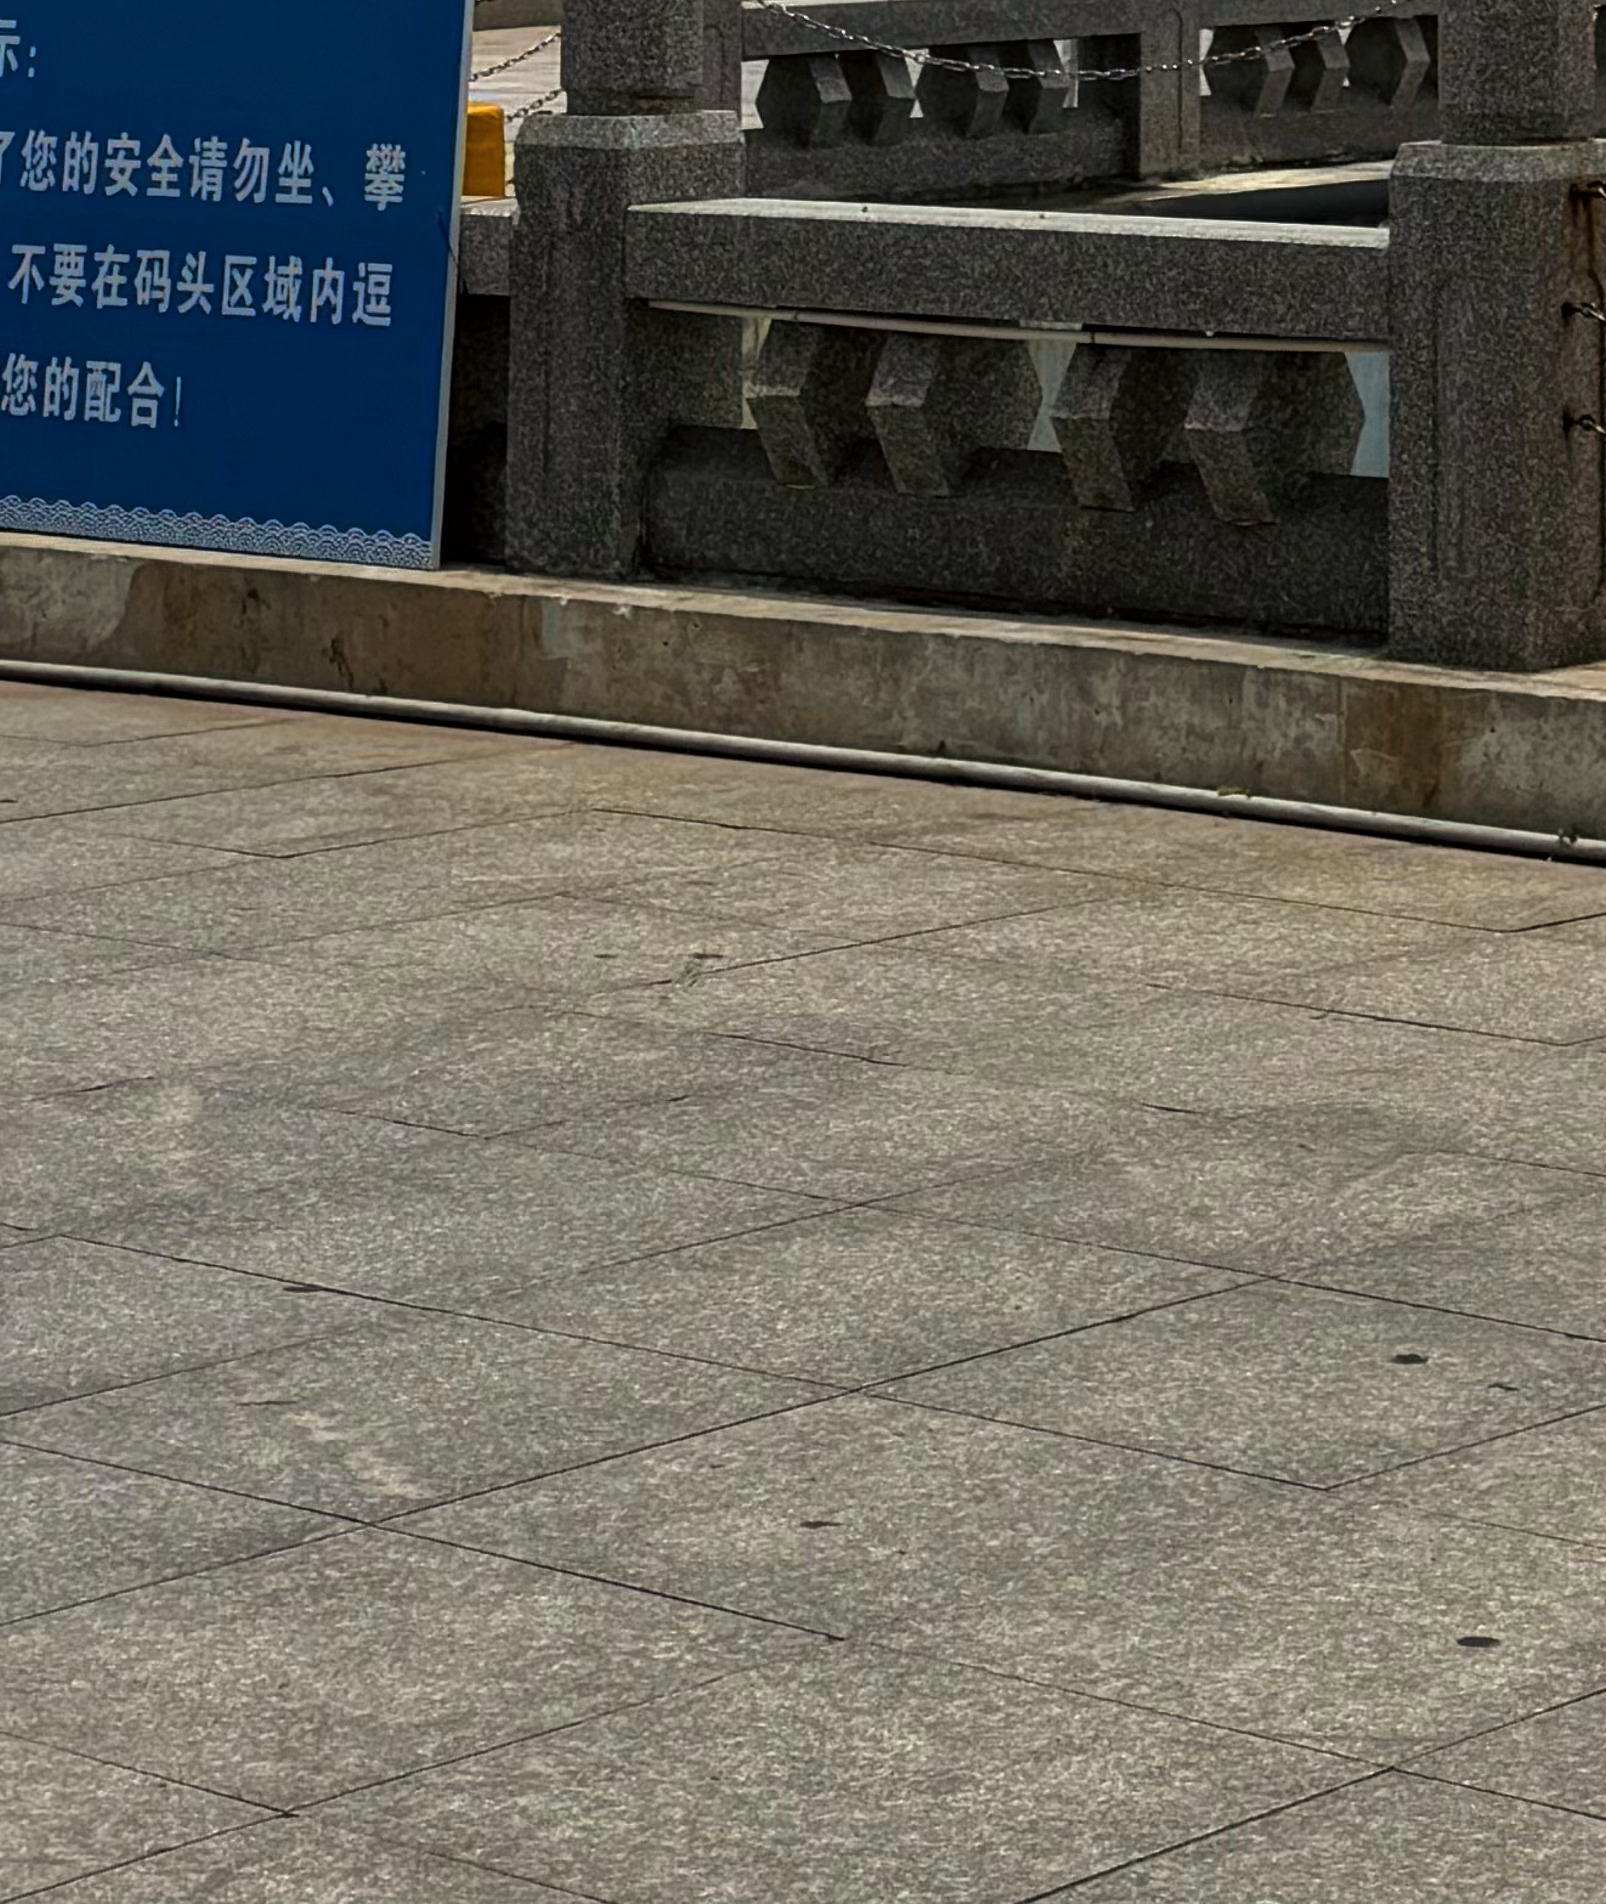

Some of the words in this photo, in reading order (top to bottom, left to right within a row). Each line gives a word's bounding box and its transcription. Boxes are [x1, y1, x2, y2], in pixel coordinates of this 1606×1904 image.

[8, 242, 394, 327] 不要在码头区域内逗
